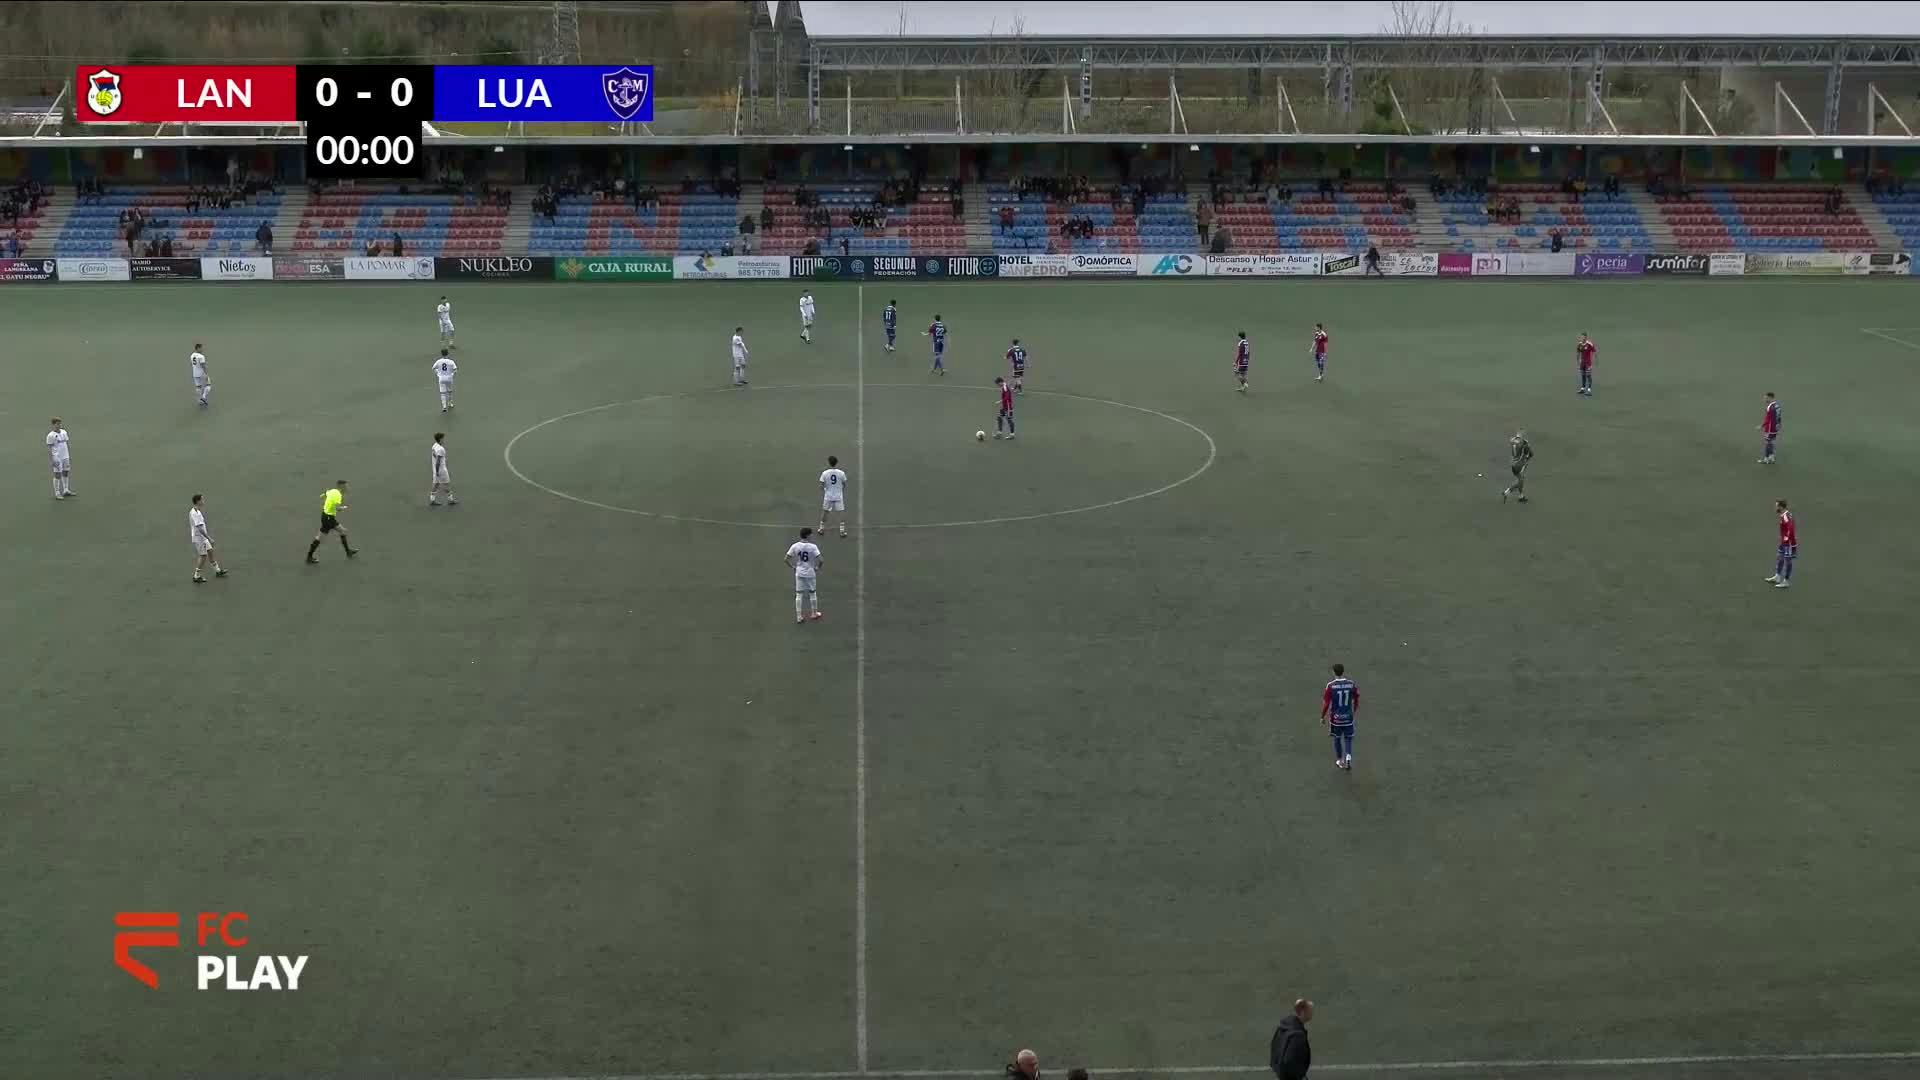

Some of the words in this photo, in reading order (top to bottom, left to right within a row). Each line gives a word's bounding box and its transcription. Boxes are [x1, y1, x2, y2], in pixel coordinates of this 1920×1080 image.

[351, 261, 364, 270] LA
[367, 260, 407, 270] POMAR
[460, 258, 532, 272] NUKLEO
[874, 257, 916, 270] SEGUNDA
[1000, 256, 1032, 265] HOTEL
[1086, 256, 1131, 265] OMÓPTICA
[1252, 257, 1257, 265] y
[1259, 255, 1285, 264] Hogar
[1287, 255, 1312, 263] Astur
[219, 259, 256, 273] Nieto's
[588, 263, 622, 273] CAJA
[625, 263, 671, 273] RURAL
[441, 362, 448, 372] 8
[830, 474, 837, 485] 9
[798, 551, 809, 562] 16
[1336, 690, 1350, 707] 11
